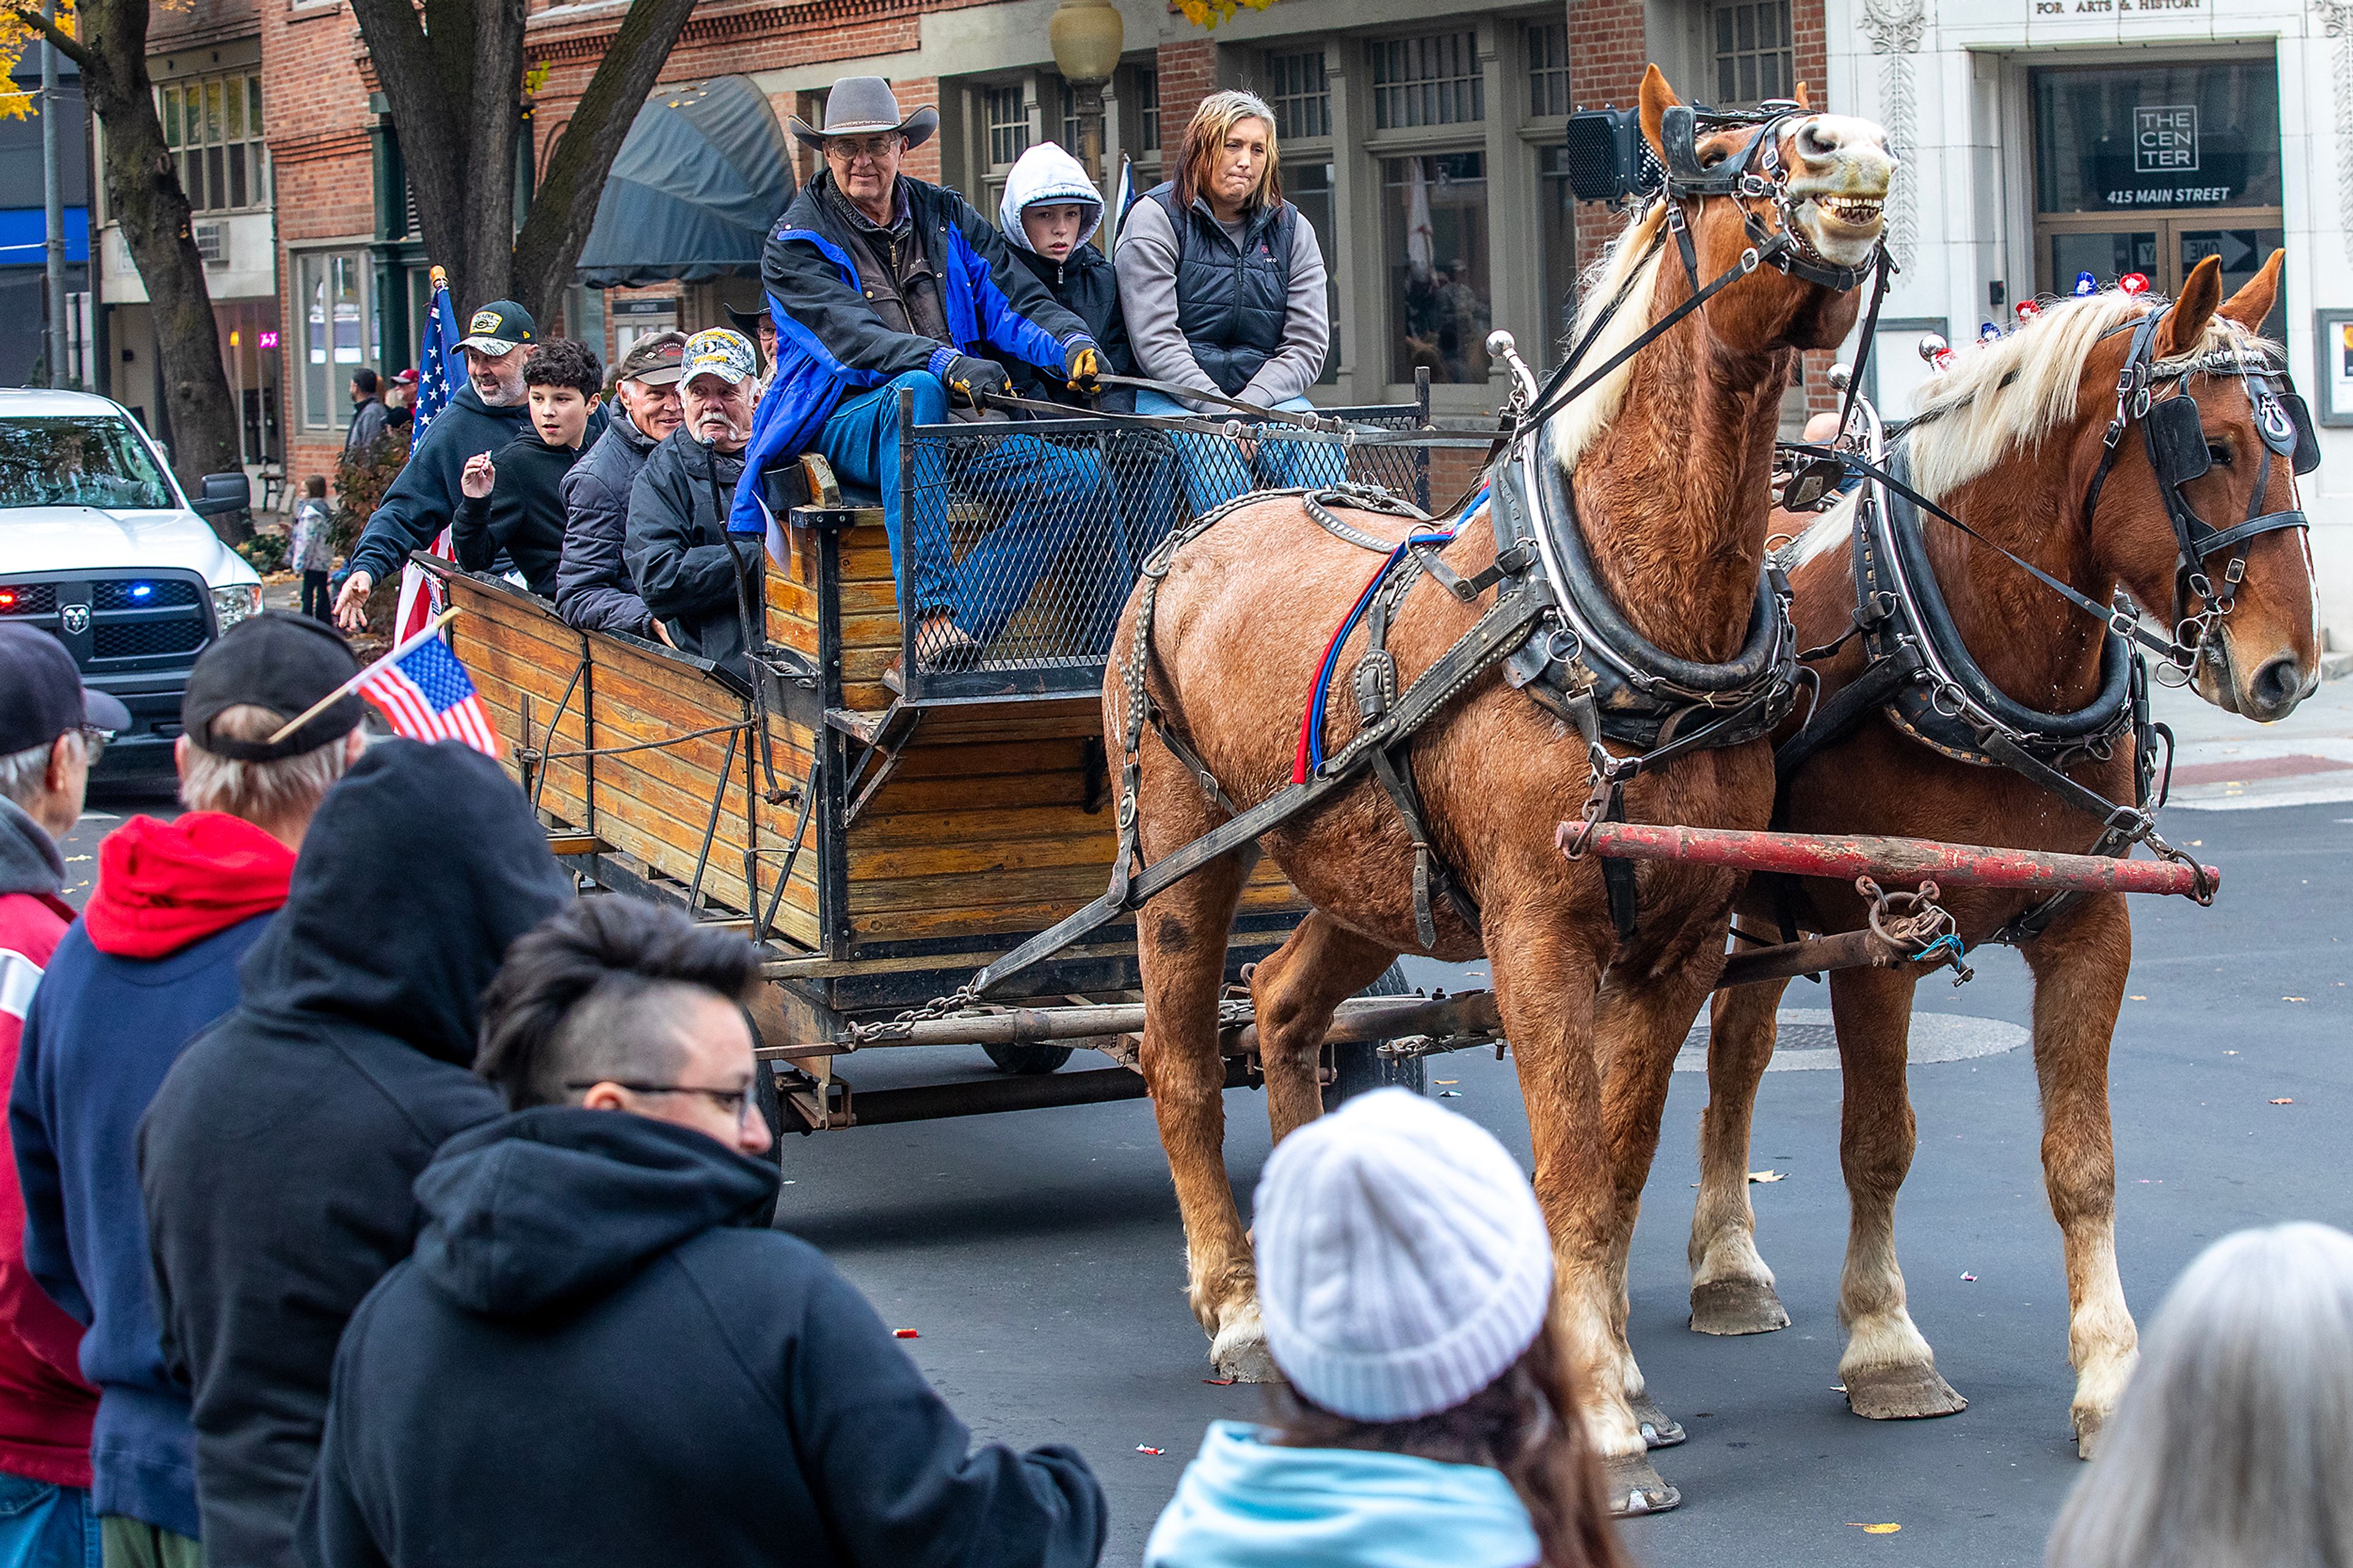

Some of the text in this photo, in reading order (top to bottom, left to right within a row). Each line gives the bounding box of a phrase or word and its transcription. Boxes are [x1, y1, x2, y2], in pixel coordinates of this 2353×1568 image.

[2036, 0, 2200, 14] FOR ARTS & HISTORY
[2140, 112, 2191, 128] THE
[2140, 131, 2192, 147] CEN
[2142, 150, 2191, 166] TER
[2107, 187, 2230, 203] 415 MAIN STREET
[705, 330, 740, 346] AIRBORNE
[694, 355, 727, 365] DIVISION
